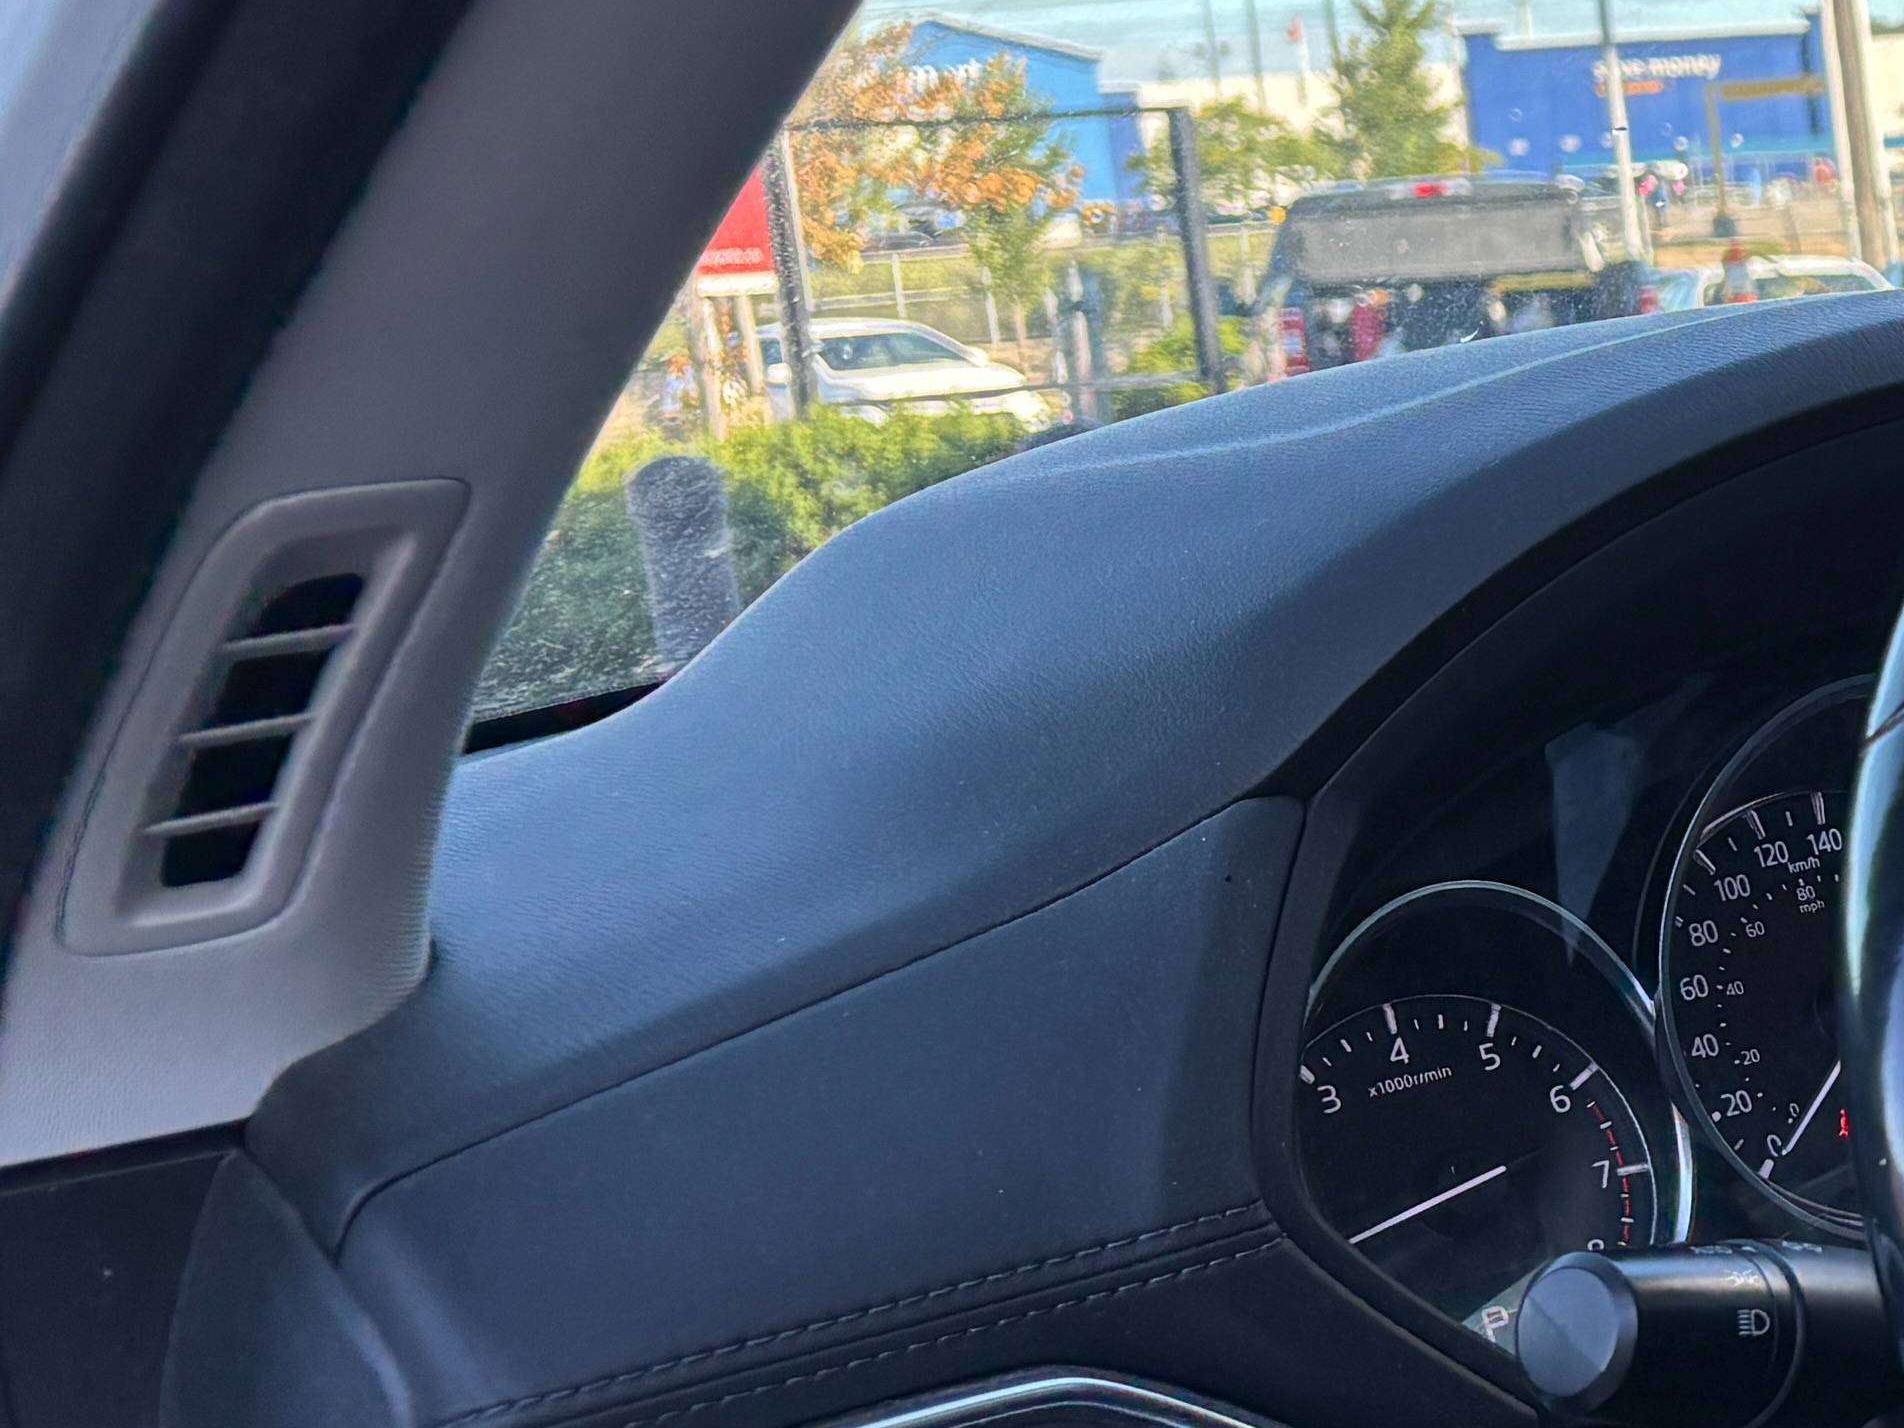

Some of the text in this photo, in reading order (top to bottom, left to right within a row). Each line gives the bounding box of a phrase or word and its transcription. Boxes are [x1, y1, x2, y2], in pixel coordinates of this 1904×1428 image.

[1753, 840, 1789, 868] 120
[1806, 828, 1843, 856] 140
[1787, 856, 1821, 874] km/h
[1713, 874, 1751, 902] 100
[1795, 885, 1817, 902] 80
[1799, 899, 1825, 915] mph
[1688, 919, 1719, 947] 80
[1744, 921, 1766, 938] 60
[1679, 974, 1709, 1002] 60
[1725, 980, 1744, 996] 40
[1389, 1036, 1410, 1065] 4
[1478, 1042, 1502, 1072] 5
[1690, 1033, 1720, 1059] 40
[1740, 1048, 1761, 1066] 20
[1316, 1083, 1342, 1115] 3
[1549, 1084, 1572, 1114] 6
[1720, 1089, 1753, 1117] 20
[1591, 1159, 1610, 1189] 7
